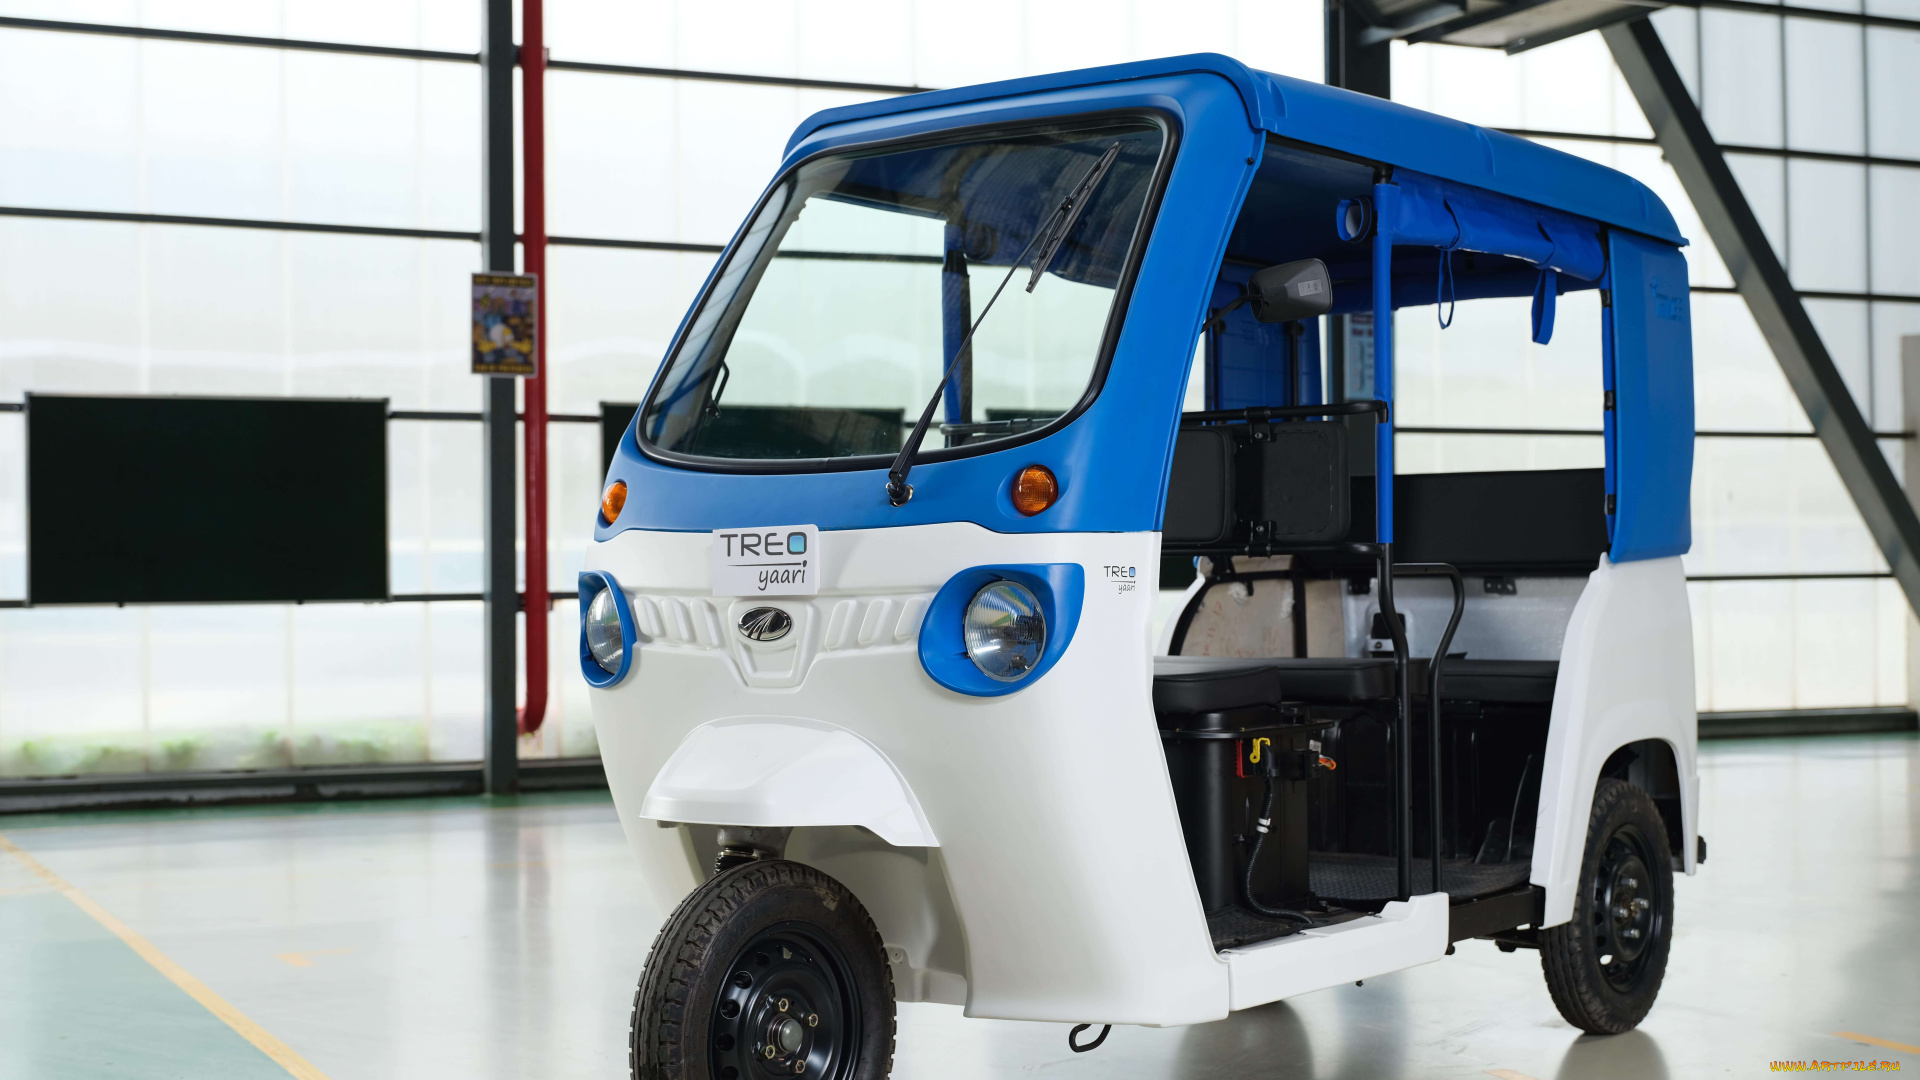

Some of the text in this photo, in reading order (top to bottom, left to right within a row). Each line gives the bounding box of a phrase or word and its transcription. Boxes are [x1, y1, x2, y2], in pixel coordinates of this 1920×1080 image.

[720, 532, 807, 557] TREO
[758, 560, 807, 591] yaari
[1103, 565, 1136, 578] TREO
